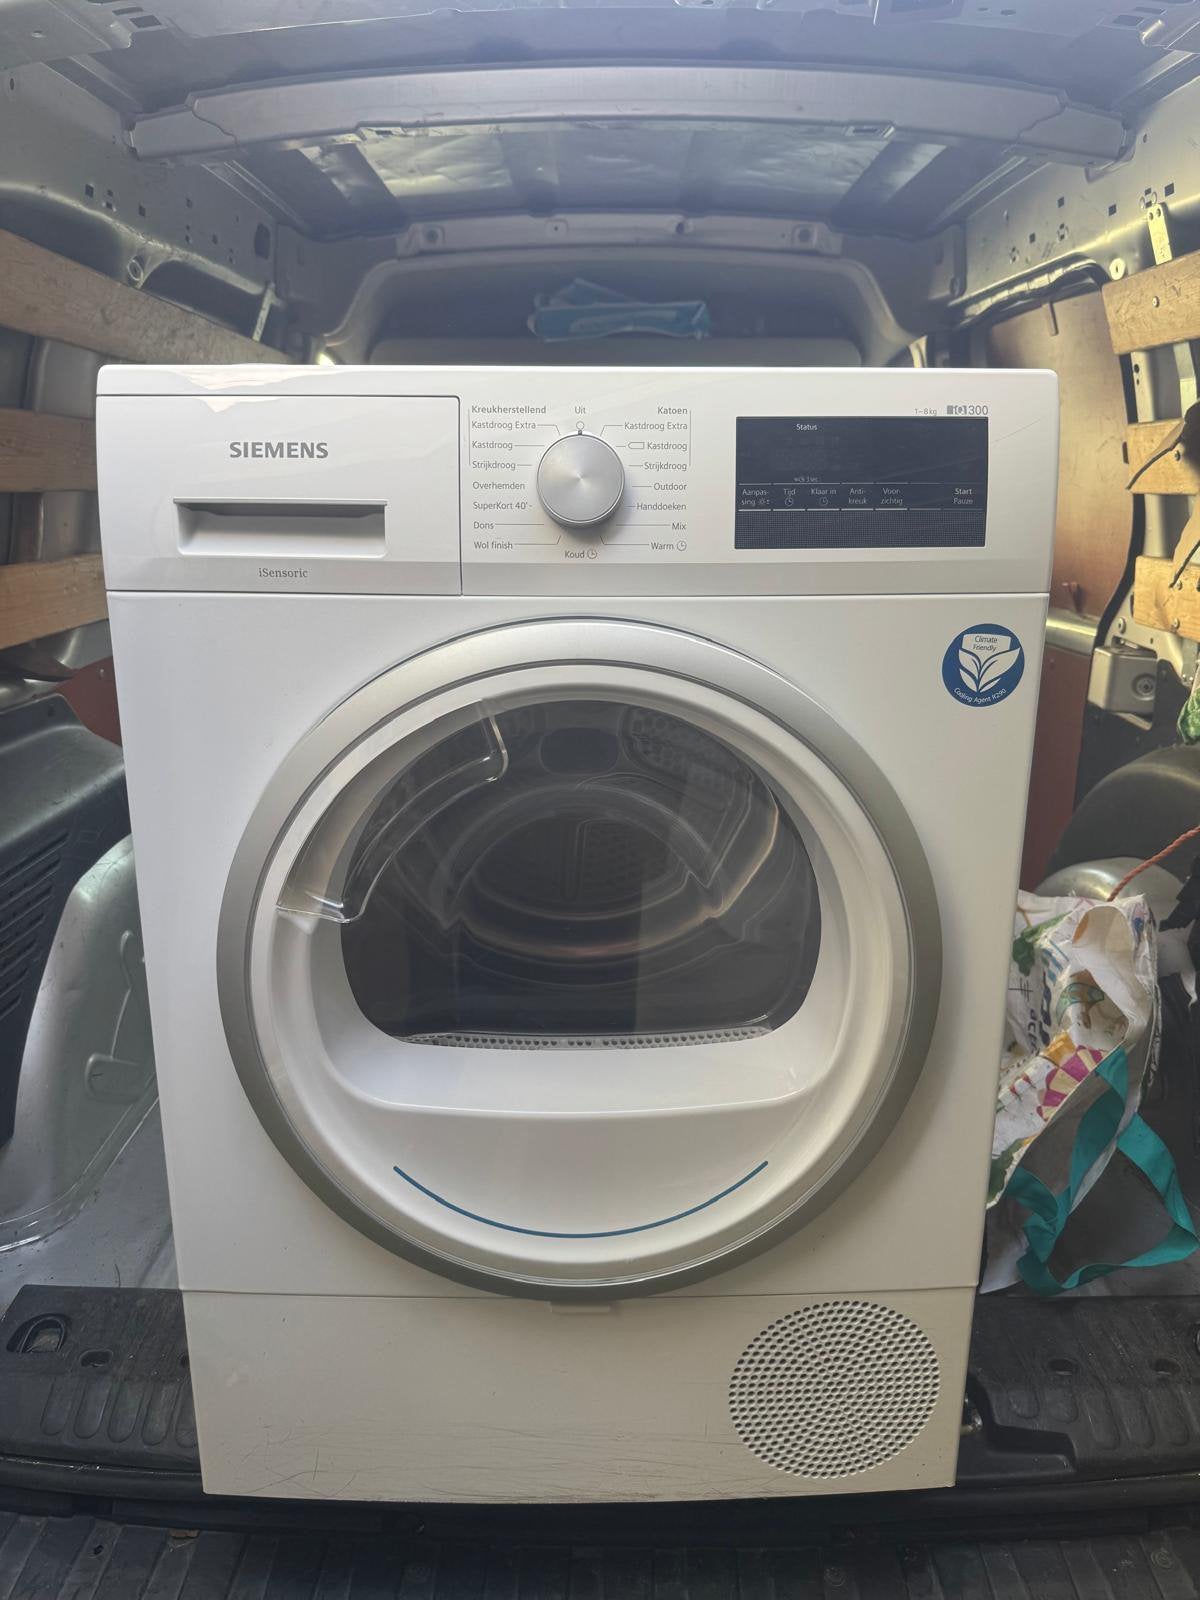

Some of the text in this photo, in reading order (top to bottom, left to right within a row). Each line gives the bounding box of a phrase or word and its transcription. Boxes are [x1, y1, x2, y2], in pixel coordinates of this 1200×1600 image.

[471, 405, 546, 414] Kreukherstellend
[574, 406, 586, 415] Uit
[657, 406, 688, 415] Katoen
[471, 420, 536, 430] Kastdroog Extra
[624, 421, 688, 431] Kastdroog Extra
[796, 423, 818, 432] Status
[472, 440, 513, 450] Kastdroog
[647, 441, 688, 451] Kastdroog
[229, 441, 329, 459] SIEMENS
[472, 460, 516, 471] Strijkdroog
[644, 461, 687, 472] Strijkdroog
[472, 481, 525, 490] Overhemden
[653, 482, 687, 491] Outdoor
[850, 487, 866, 495] Anti-
[954, 487, 973, 495] Start
[473, 501, 513, 511] SuperKort
[636, 502, 687, 511] Handdoeken
[880, 498, 903, 506] zichtig
[953, 498, 974, 506] Pauze
[473, 521, 494, 530] Dons
[671, 522, 687, 531] Mix
[474, 541, 513, 550] Wol finish
[650, 542, 674, 551] Warm
[564, 551, 585, 559] Koud
[258, 567, 308, 578] iSensoric
[974, 635, 998, 644] Climate
[973, 644, 997, 652] Friendly
[954, 687, 1008, 705] Cooling Agent R290
